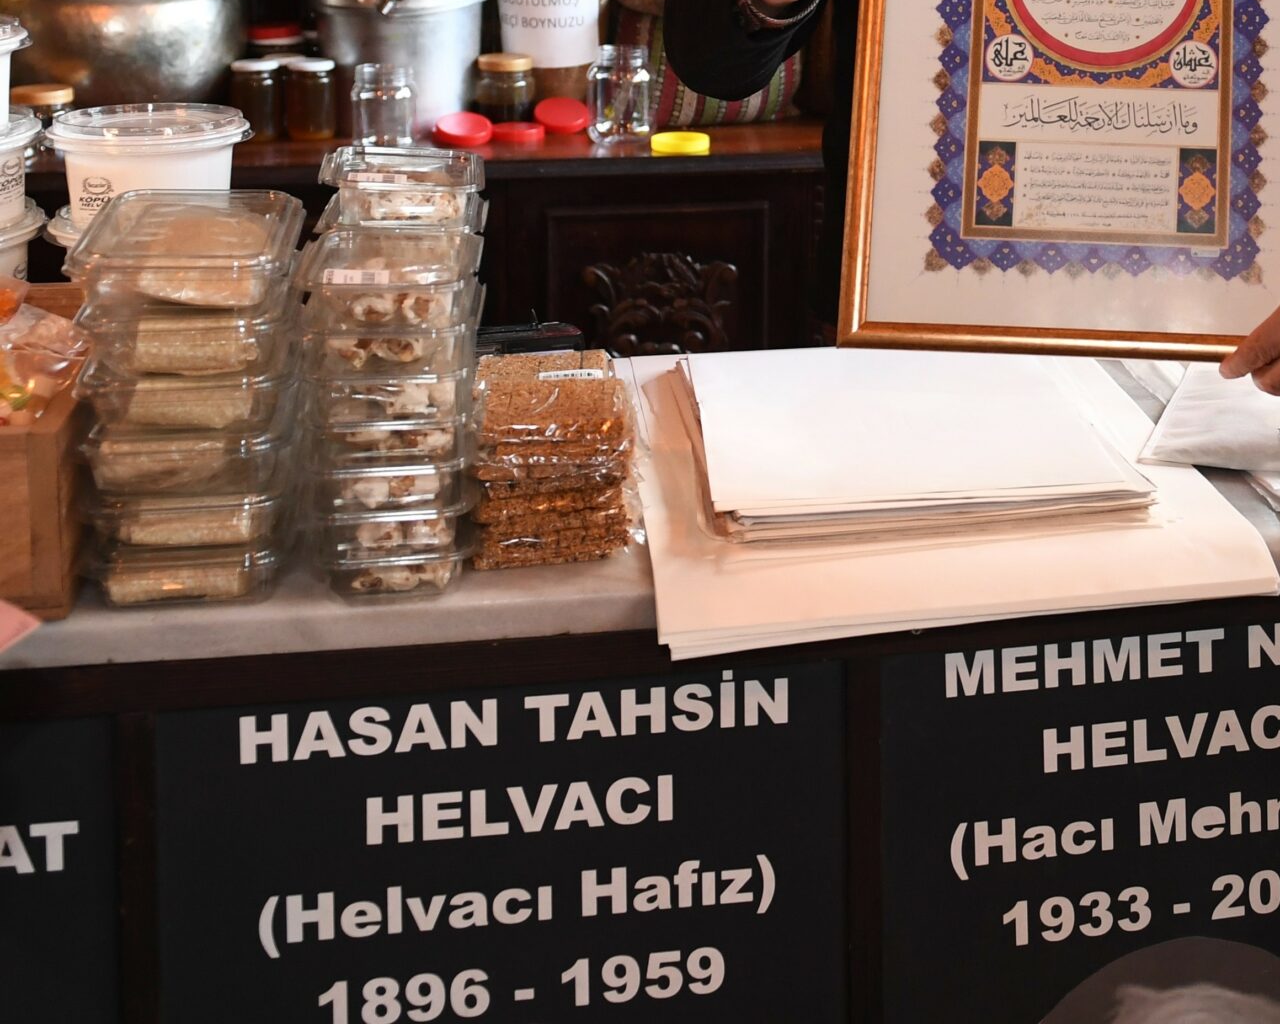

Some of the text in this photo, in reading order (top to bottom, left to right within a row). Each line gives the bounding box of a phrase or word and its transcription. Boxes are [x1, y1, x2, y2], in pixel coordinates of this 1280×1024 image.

[521, 15, 585, 29] BOYNUZU
[944, 628, 1225, 698] MEHMET
[239, 670, 789, 764] HASAN TAHSİN
[366, 775, 674, 846] HELVACI
[0, 821, 79, 874] AT
[950, 818, 1115, 881] (Hacı
[258, 855, 777, 959] (Helvacı Hafız)
[1002, 886, 1152, 946] 1933
[318, 969, 491, 1024] 1896
[561, 946, 726, 1007] 1959
